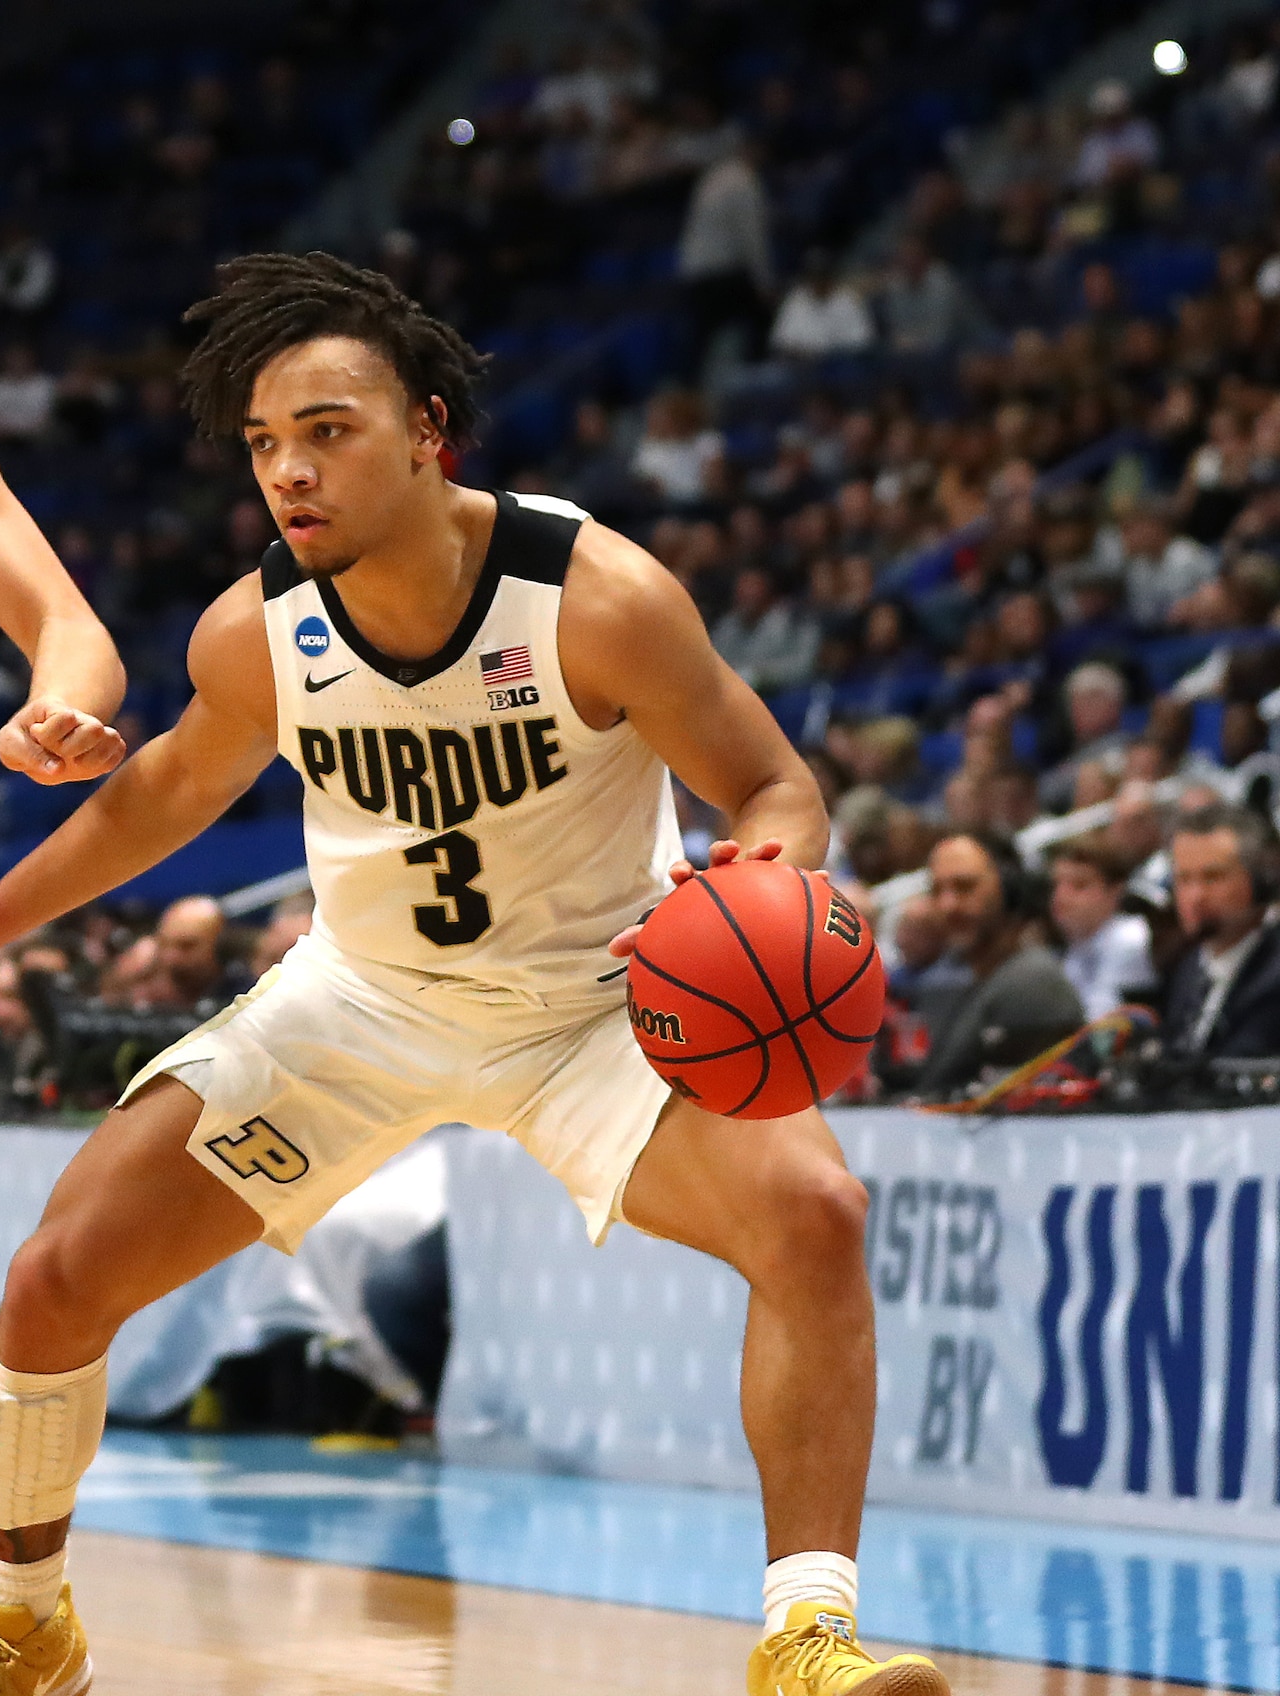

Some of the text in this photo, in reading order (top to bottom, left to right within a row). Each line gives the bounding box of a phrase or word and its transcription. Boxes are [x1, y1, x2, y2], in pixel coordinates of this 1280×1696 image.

[298, 634, 328, 647] NCAA
[296, 716, 568, 831] PURDUE
[403, 828, 492, 947] 3
[204, 1115, 310, 1184] P
[918, 1334, 993, 1465] BY
